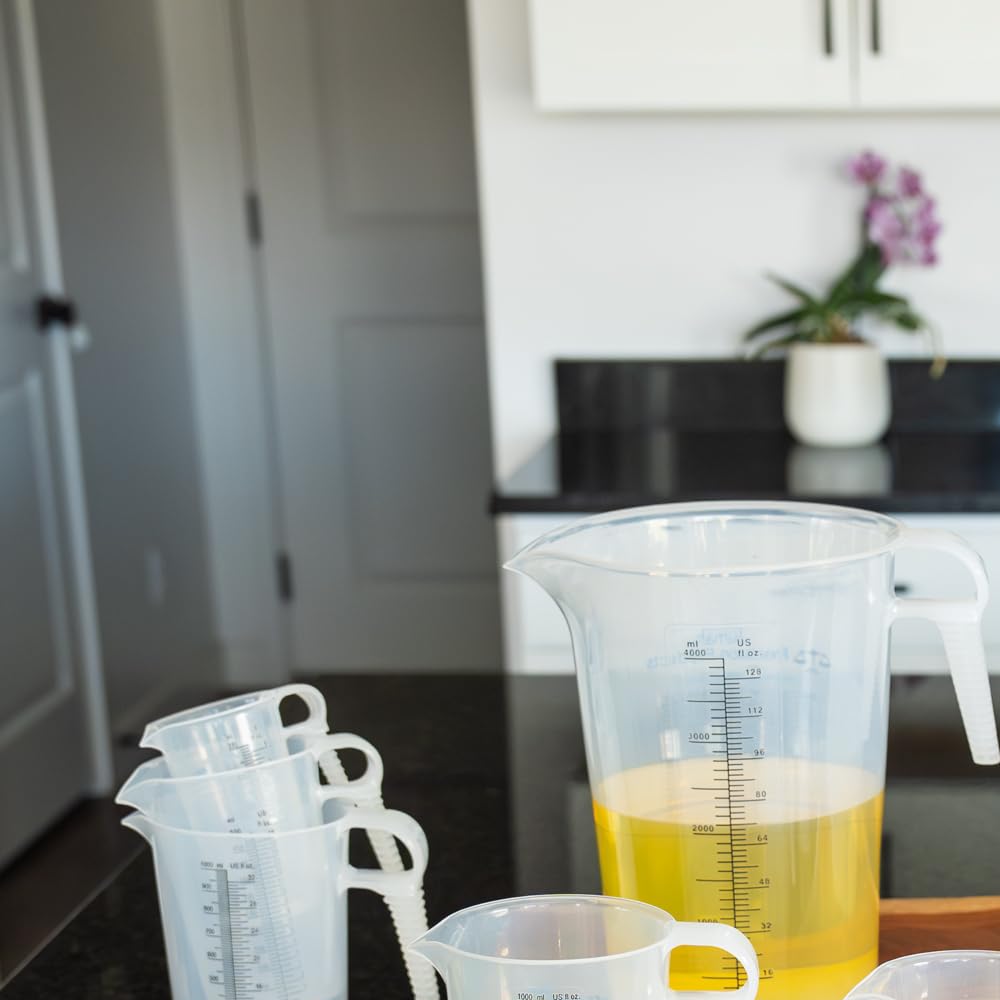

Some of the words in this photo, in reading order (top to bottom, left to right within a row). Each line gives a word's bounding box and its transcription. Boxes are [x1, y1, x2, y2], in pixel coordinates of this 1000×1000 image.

[687, 640, 698, 648] ml
[746, 668, 762, 676] 128
[757, 834, 768, 842] 64
